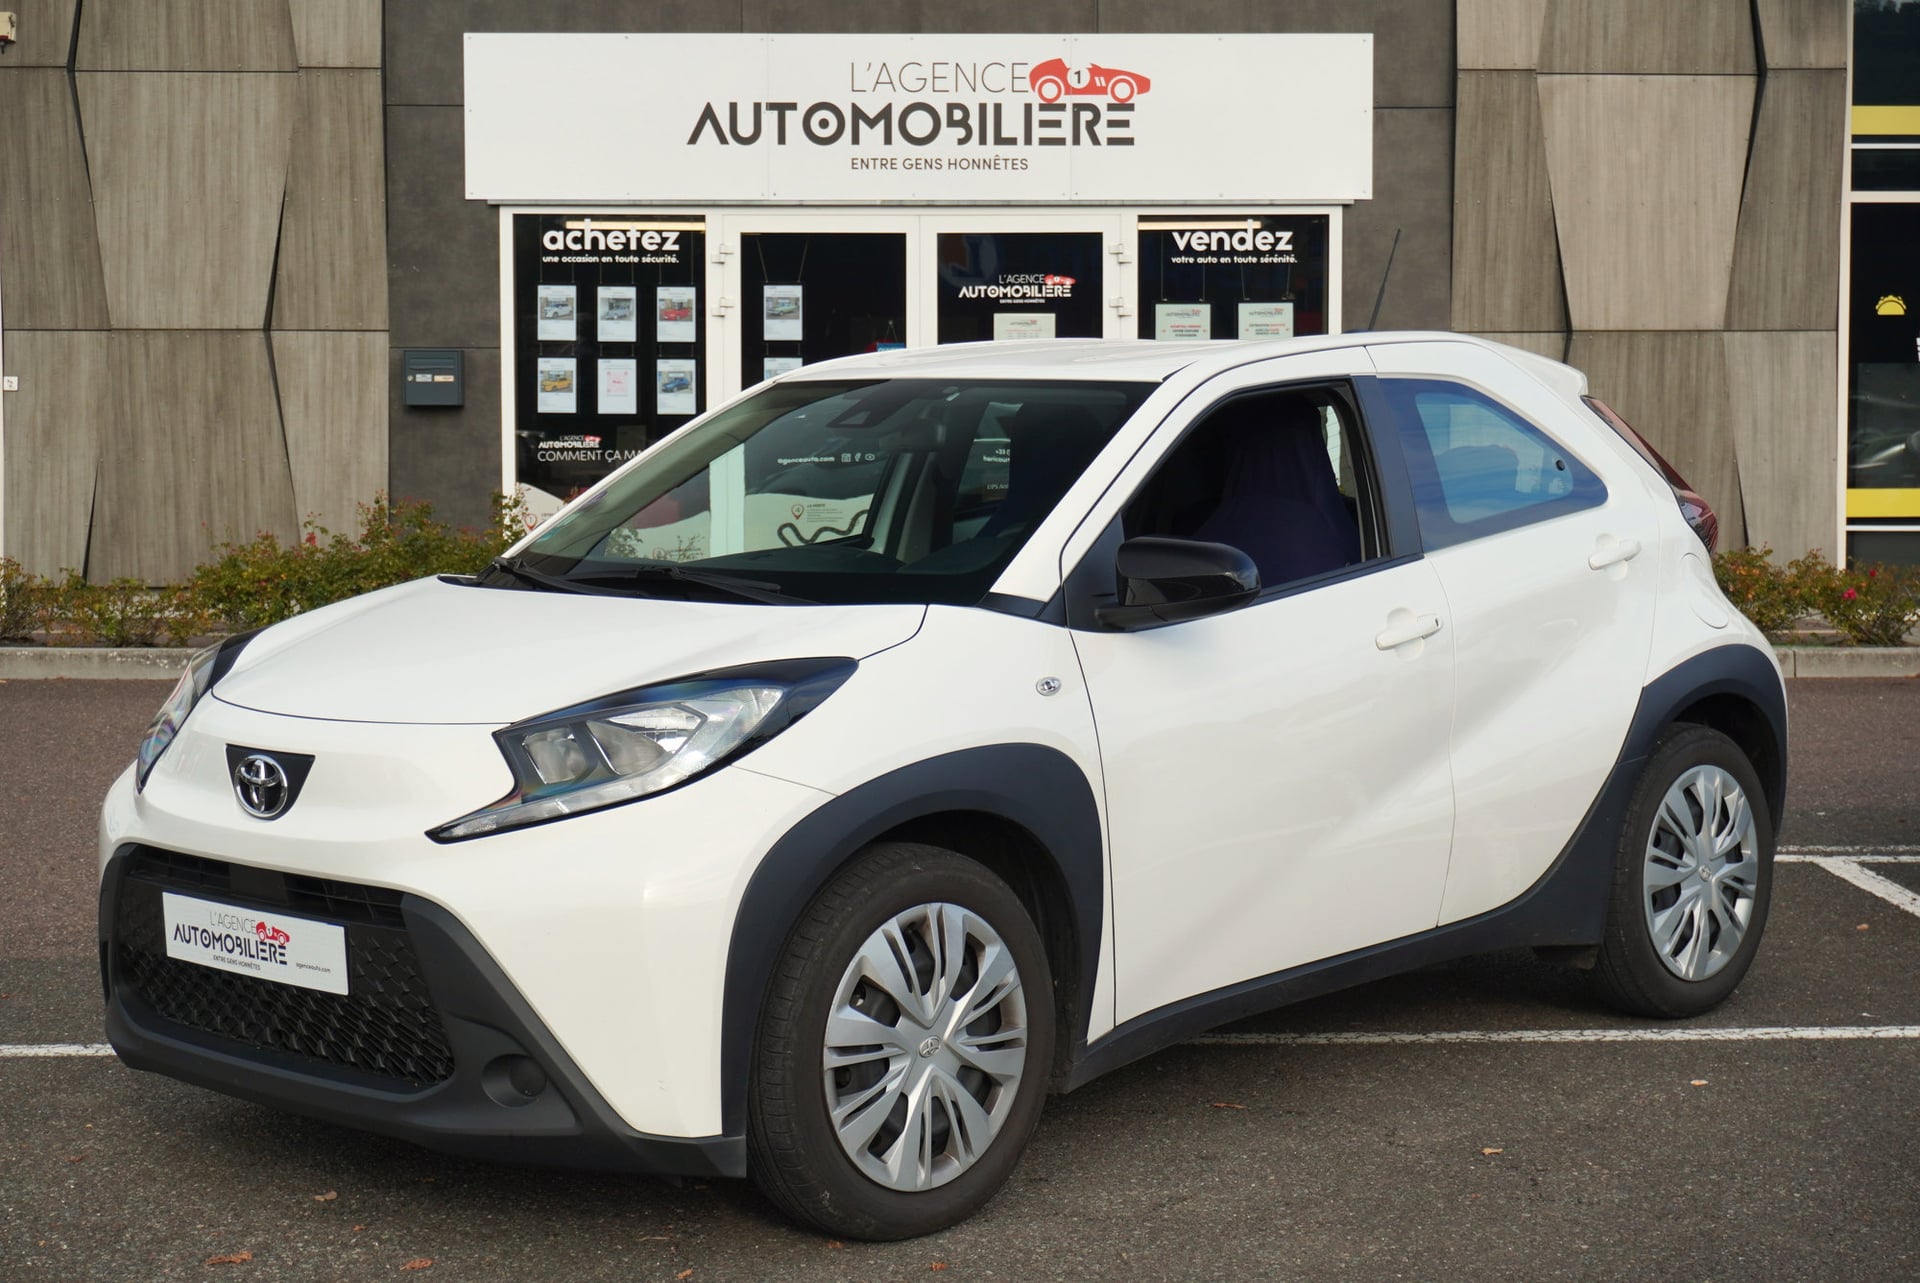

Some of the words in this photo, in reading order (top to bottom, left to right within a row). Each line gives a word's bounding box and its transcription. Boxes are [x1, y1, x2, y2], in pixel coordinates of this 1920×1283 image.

[851, 62, 1029, 93] L'AGENCE
[851, 158, 898, 170] ENTRE
[903, 158, 943, 170] GENS
[948, 155, 1029, 170] HONNÊTES
[543, 218, 680, 251] achetez
[1172, 218, 1293, 252] vendez
[561, 254, 599, 263] occasion
[615, 255, 639, 263] toute
[641, 254, 680, 263] sécurité.
[1260, 254, 1298, 263] sérénité.
[999, 274, 1044, 284] L'AGENCE
[537, 450, 602, 461] COMMENT
[604, 449, 621, 463] ÇA
[209, 911, 257, 935] L'AGENCE
